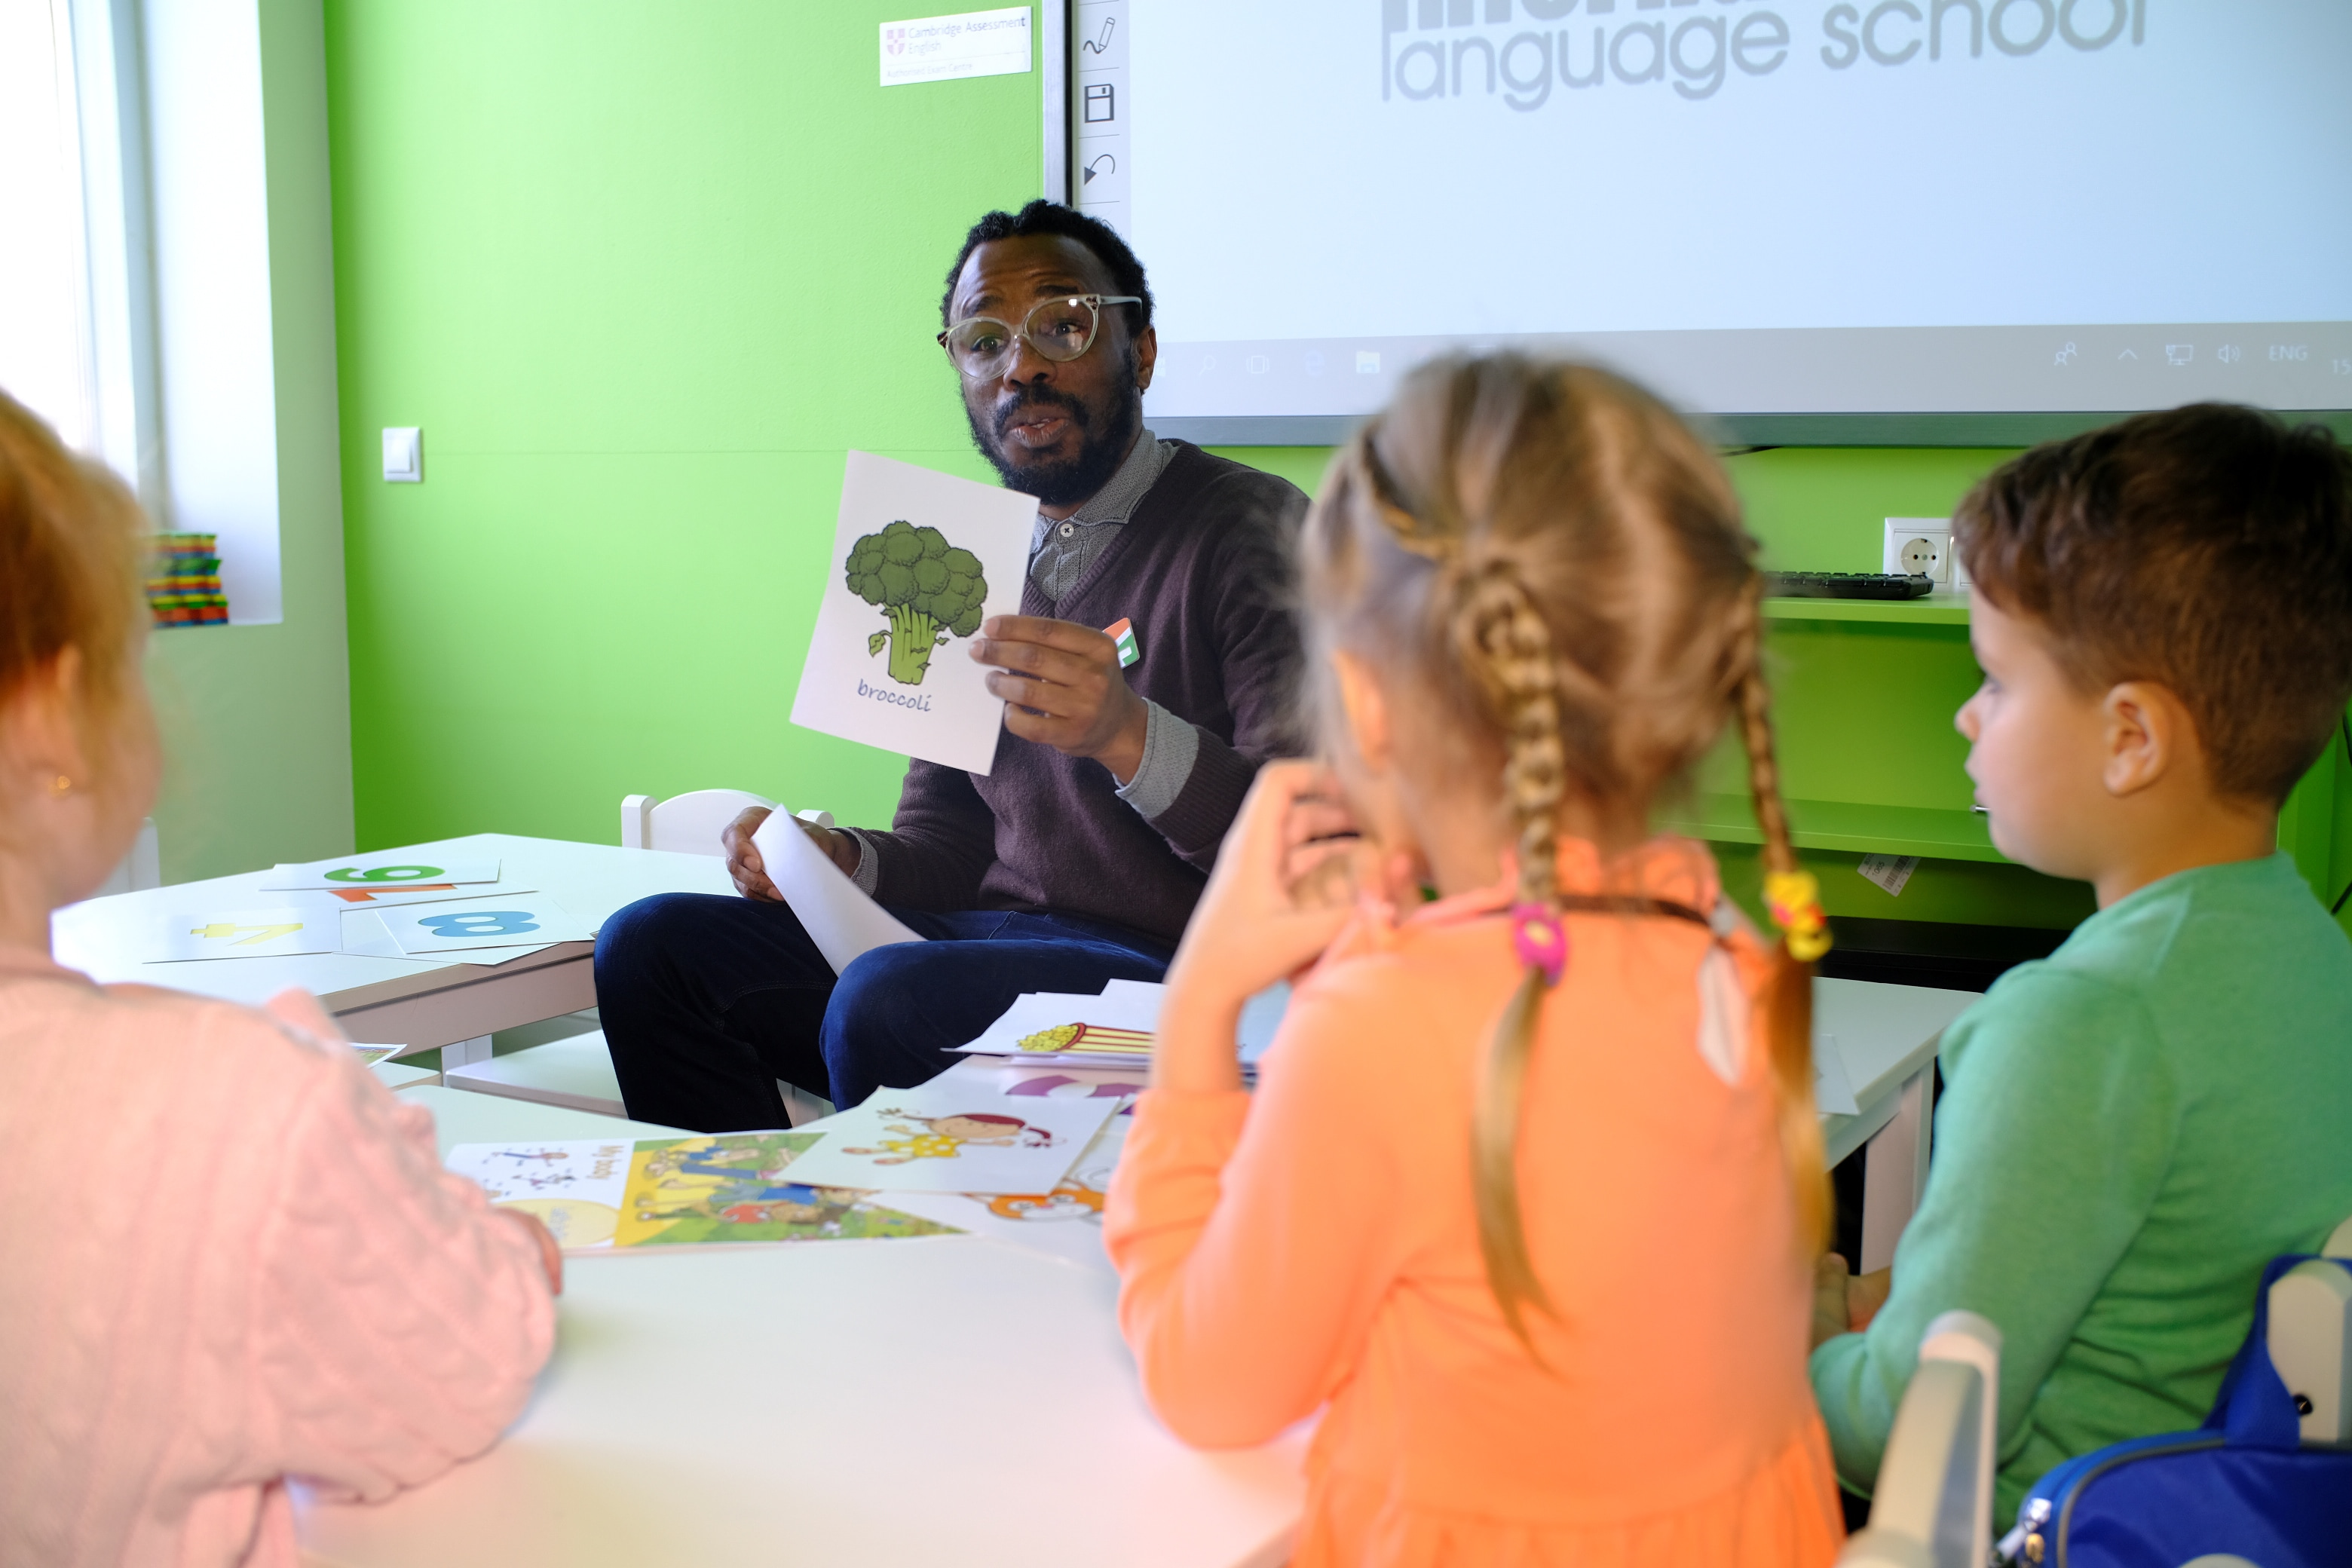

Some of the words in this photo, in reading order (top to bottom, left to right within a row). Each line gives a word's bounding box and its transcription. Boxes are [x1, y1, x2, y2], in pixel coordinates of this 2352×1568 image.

[908, 23, 961, 39] Cambridge
[966, 16, 1026, 32] Assessment
[908, 41, 942, 57] English
[1382, 9, 1790, 112] language
[2268, 345, 2308, 362] ENG
[857, 678, 932, 712] broccoli
[418, 911, 541, 938] 8
